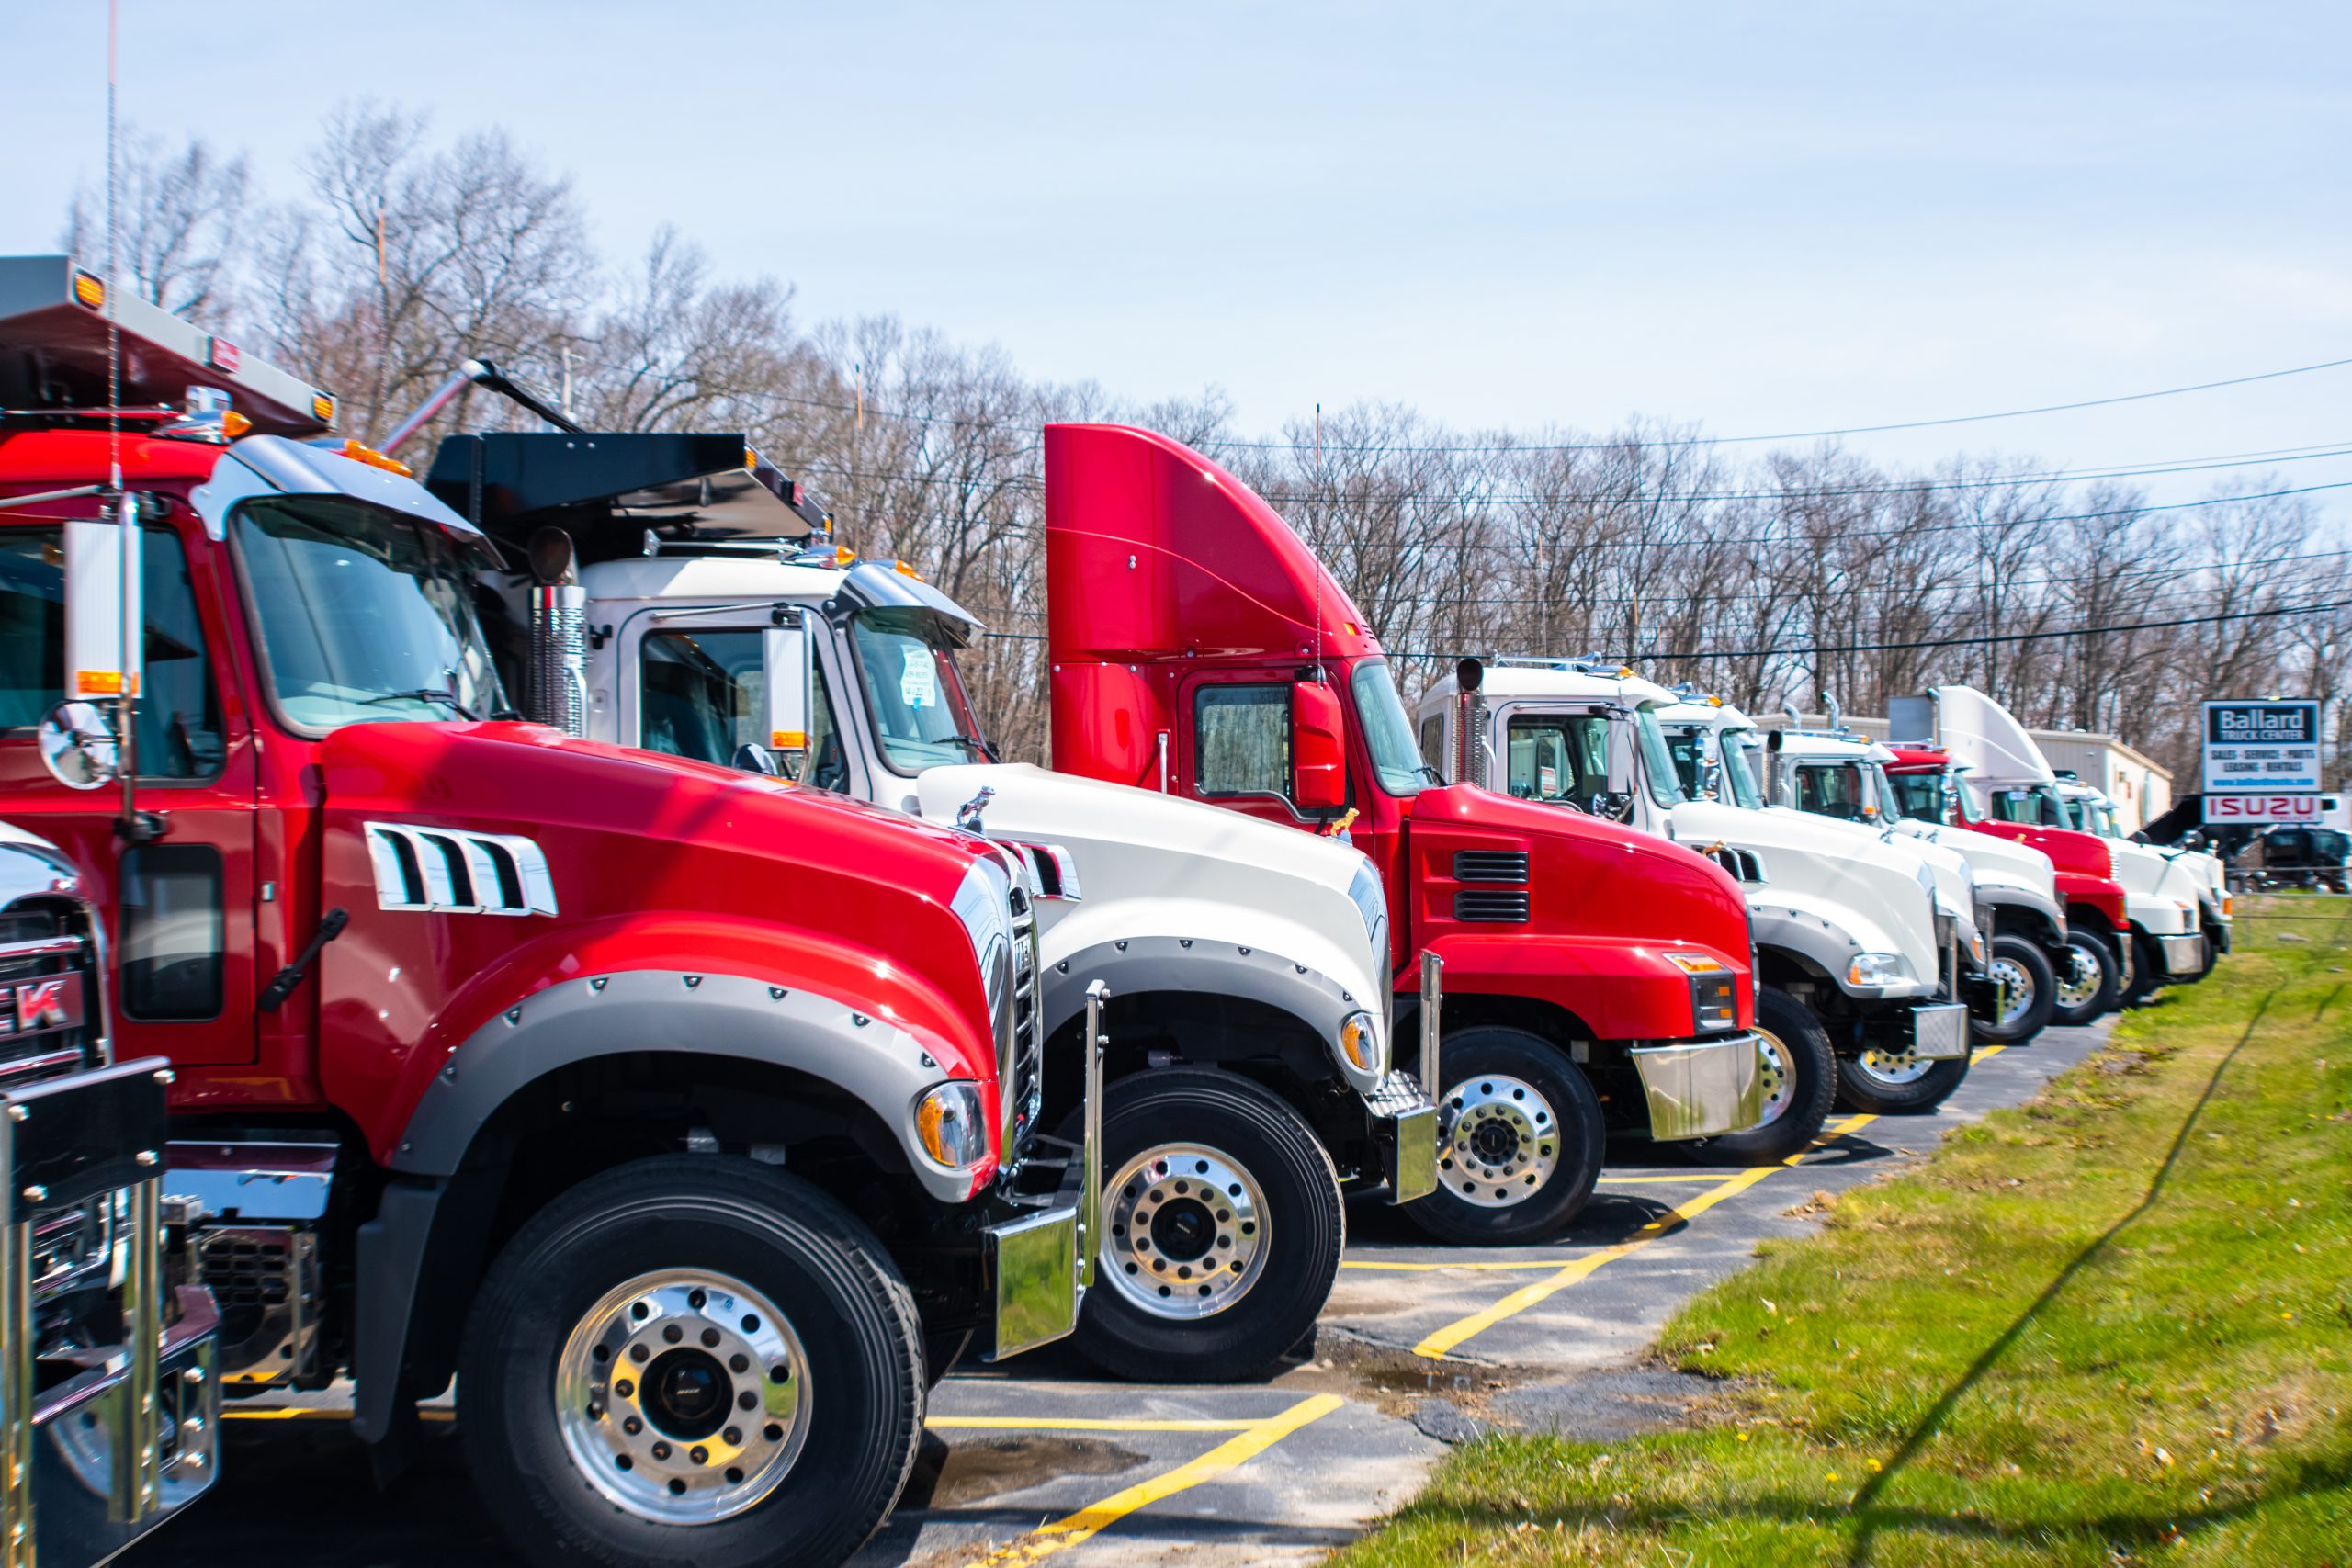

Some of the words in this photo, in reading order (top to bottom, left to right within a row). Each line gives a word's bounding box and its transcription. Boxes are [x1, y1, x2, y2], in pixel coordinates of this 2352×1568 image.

[2221, 708, 2305, 729] Ballard
[2222, 730, 2258, 740] TRUCK
[2260, 729, 2305, 740] CENTER
[2209, 797, 2314, 815] ISUZU
